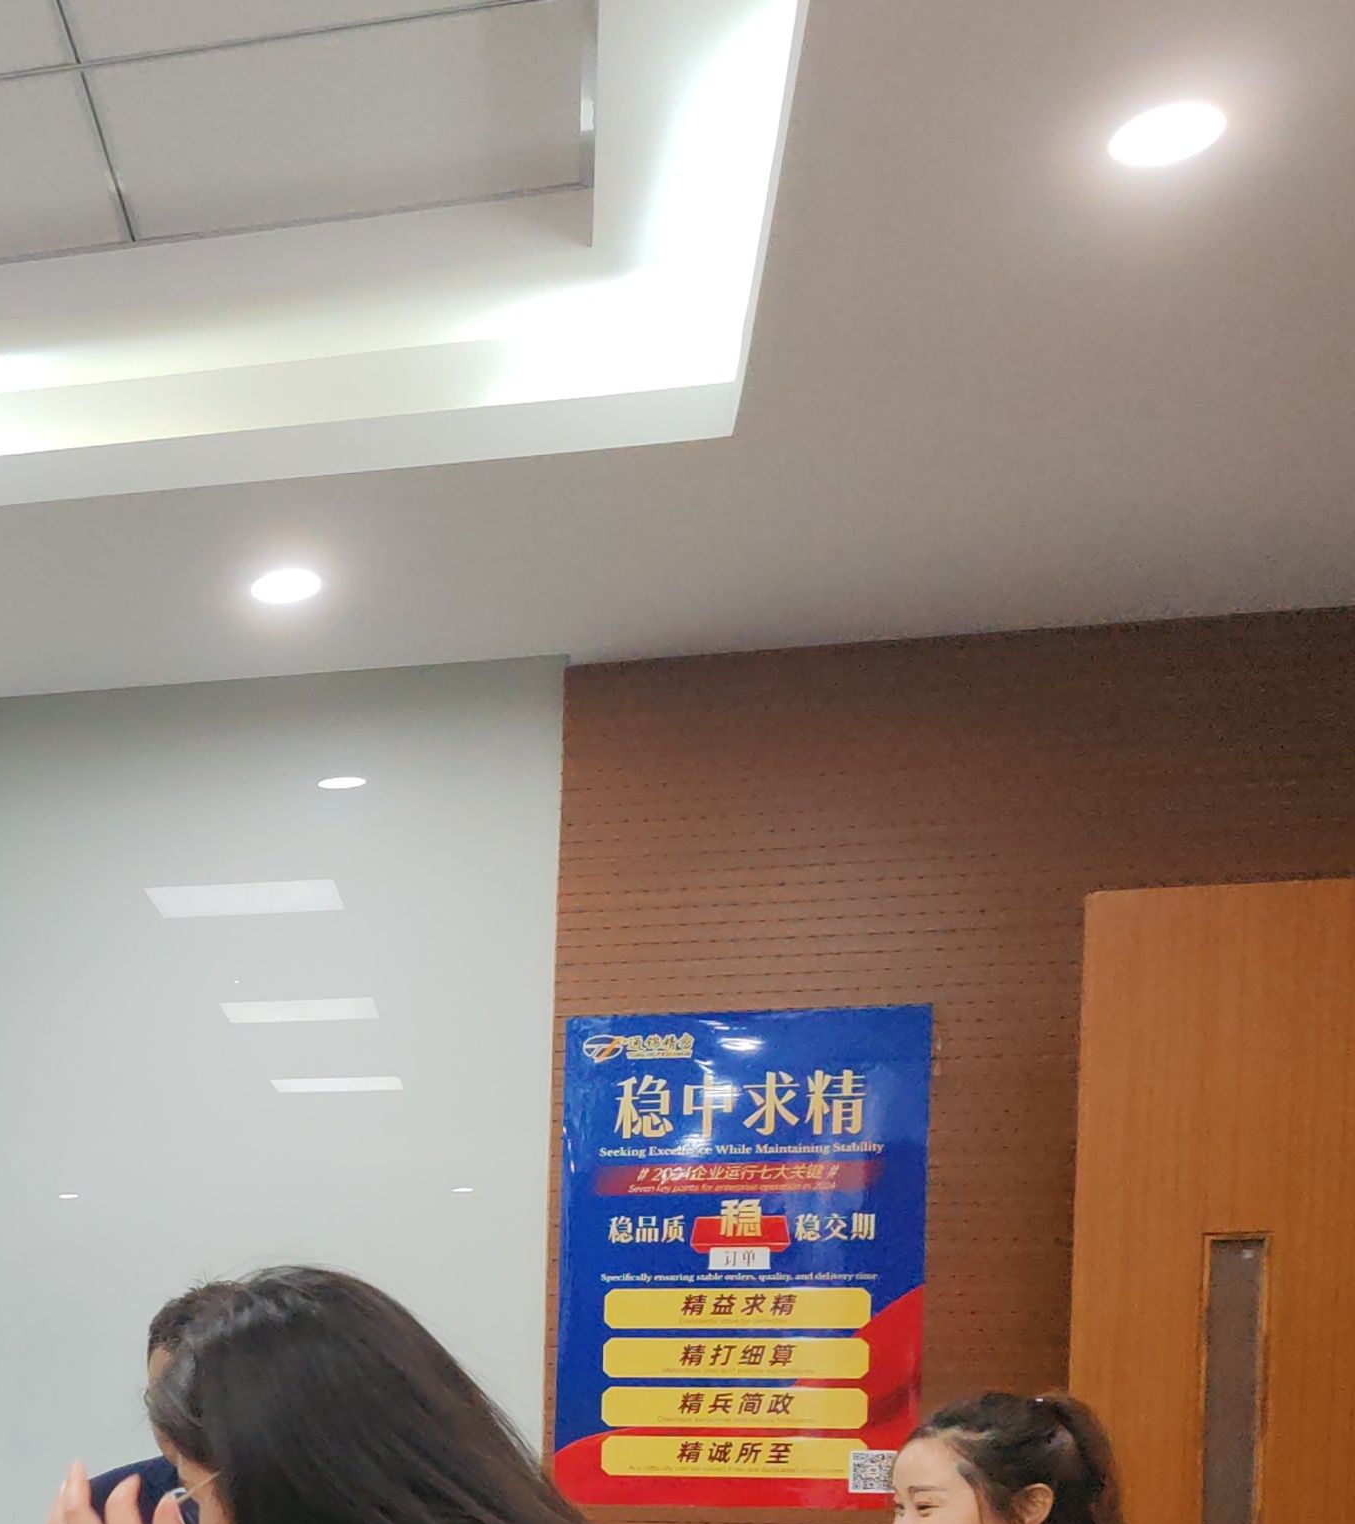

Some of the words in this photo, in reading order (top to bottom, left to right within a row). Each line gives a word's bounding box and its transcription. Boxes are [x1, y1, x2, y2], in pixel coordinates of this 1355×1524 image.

[614, 1069, 867, 1139] 稳中求精
[599, 1147, 646, 1158] Seeking
[716, 1144, 752, 1154] While
[756, 1143, 829, 1156] Maintaining
[833, 1141, 884, 1154] Stability
[608, 1215, 686, 1244] 稳品质
[720, 1198, 762, 1238] 稳
[795, 1212, 877, 1243] 稳交期
[724, 1249, 757, 1267] 订单
[600, 1273, 651, 1283] Specifically
[696, 1272, 723, 1281] stable
[680, 1294, 797, 1316] 精益求精
[678, 1344, 796, 1367] 精打细算
[677, 1393, 795, 1415] 精兵简政
[676, 1441, 793, 1464] 精诚所至
